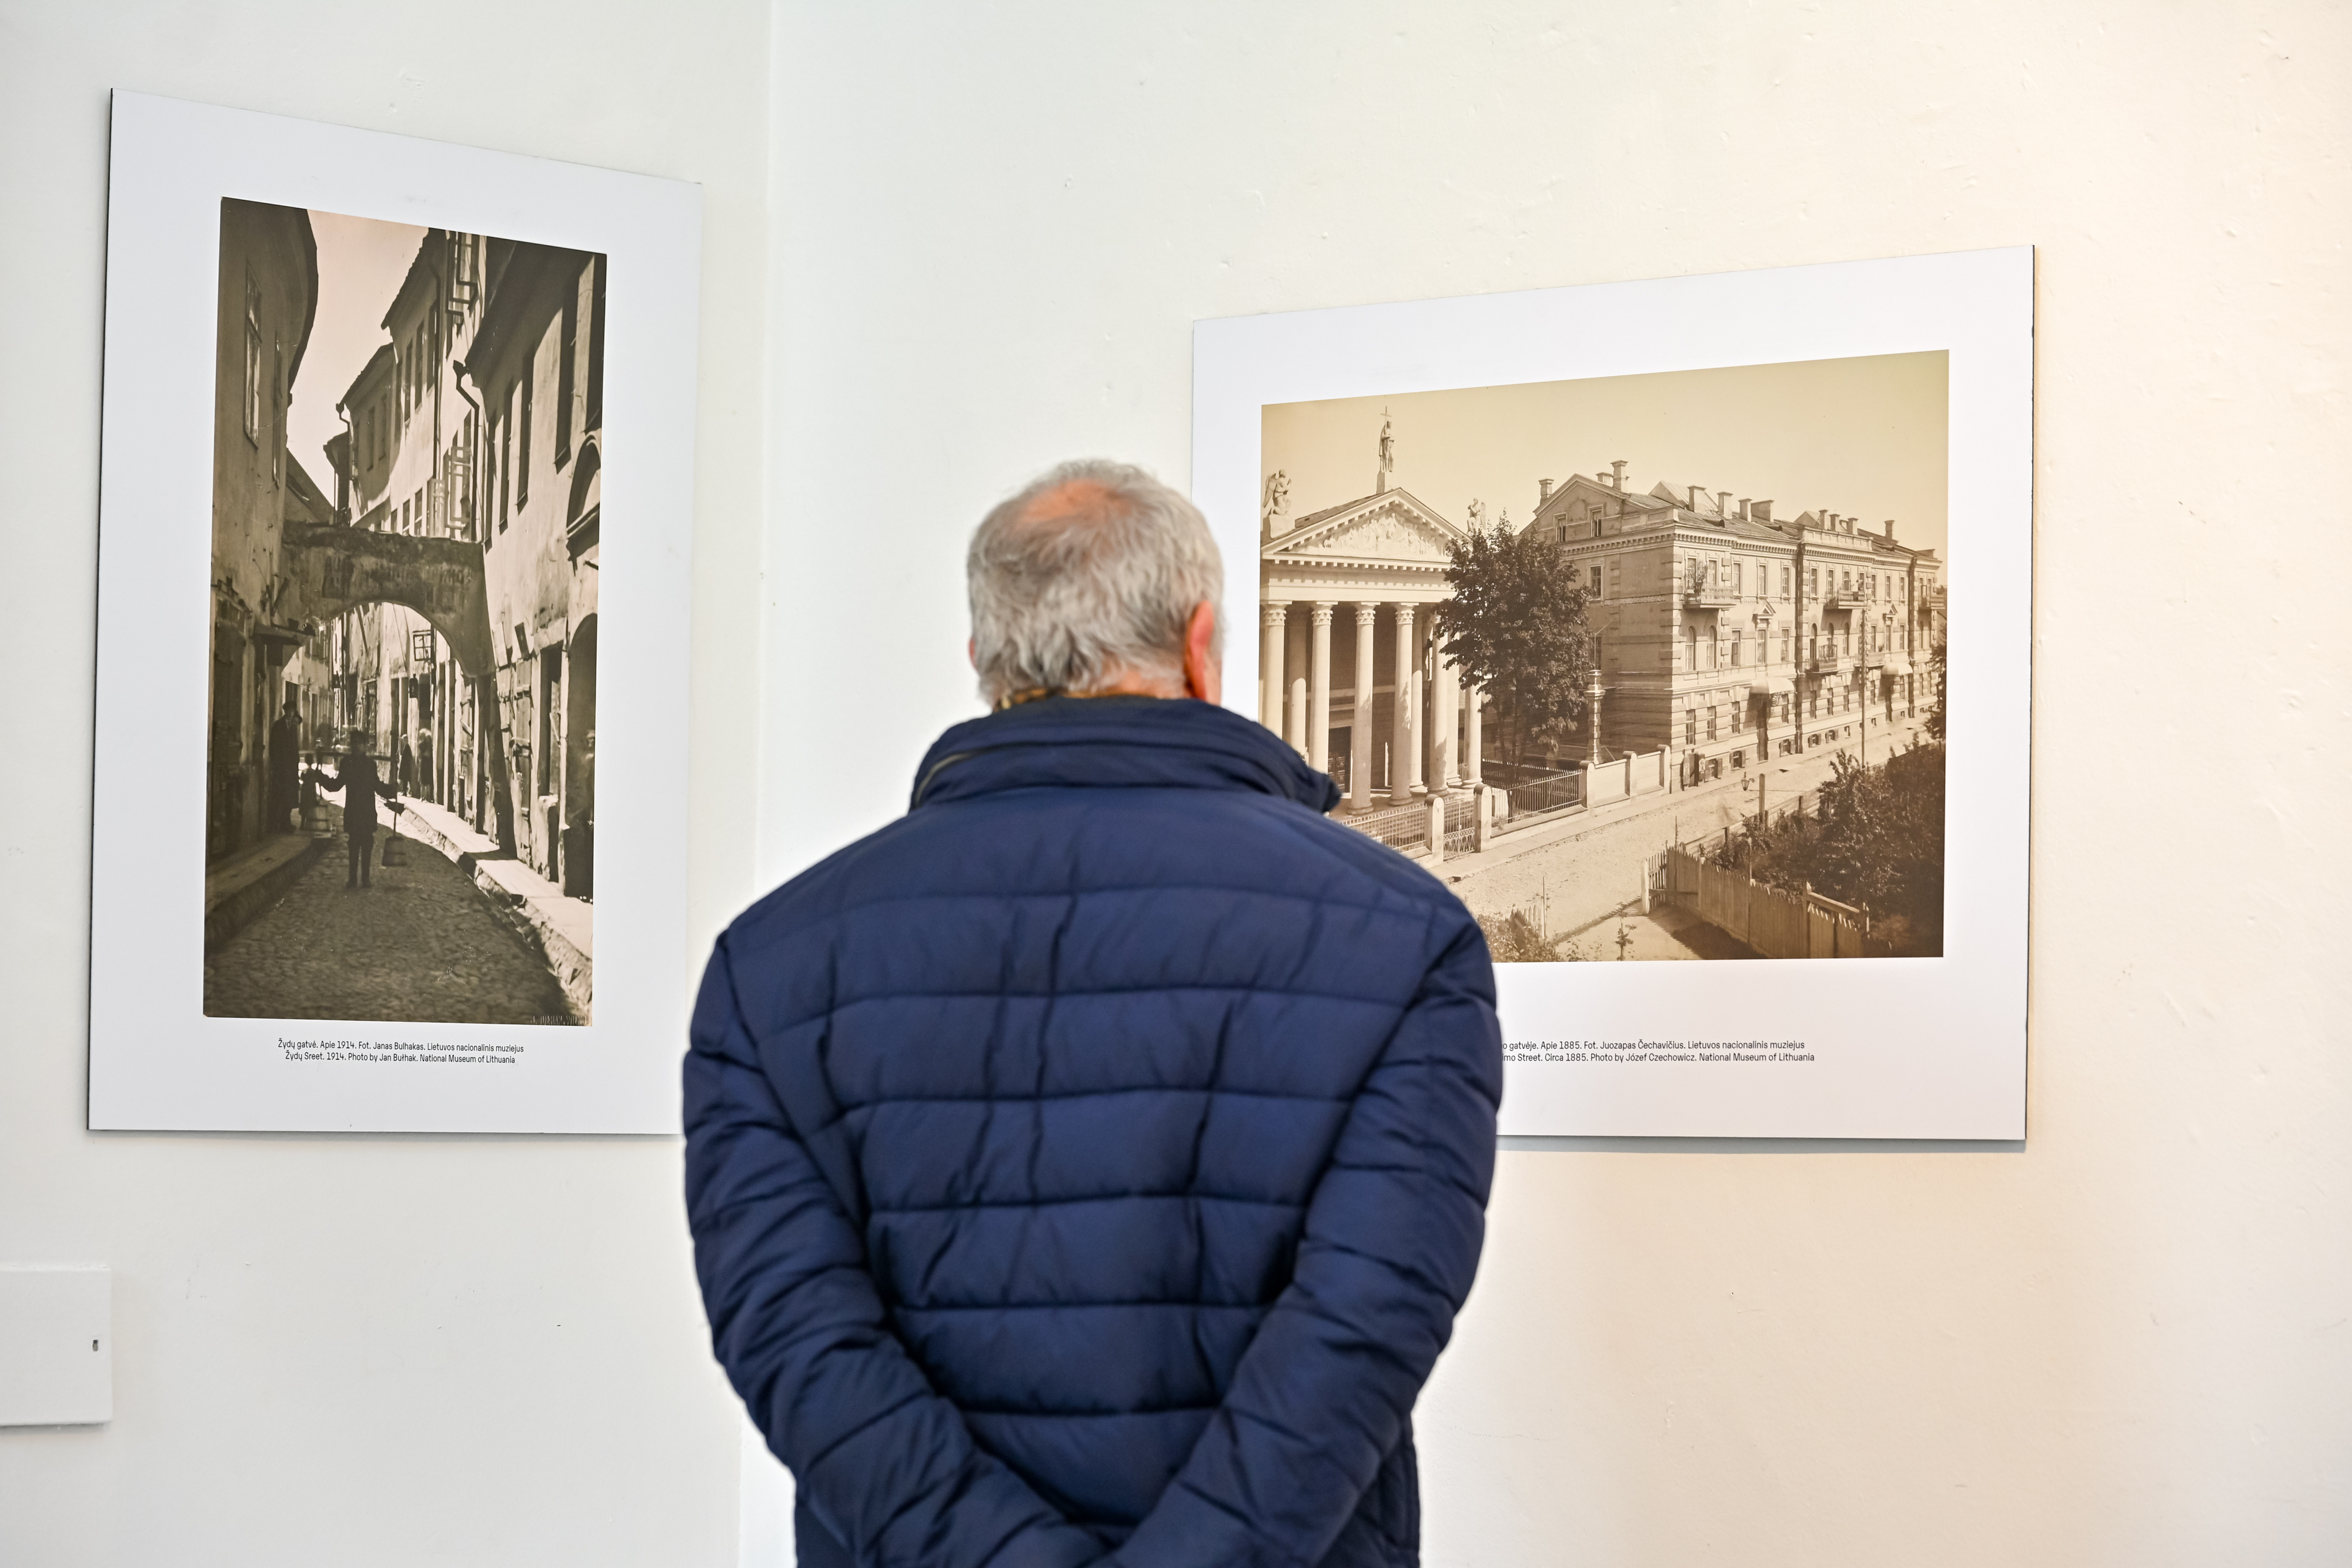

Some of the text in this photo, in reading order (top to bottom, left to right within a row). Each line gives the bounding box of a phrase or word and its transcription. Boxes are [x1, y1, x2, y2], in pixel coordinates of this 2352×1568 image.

[278, 1038, 295, 1049] Žydų
[297, 1041, 318, 1049] gatvė.
[320, 1041, 335, 1050] Apie
[338, 1041, 356, 1049] 1914.
[395, 1042, 425, 1050] Bulhakas.
[427, 1042, 455, 1051] Lietuvos
[496, 1044, 524, 1054] muziejus
[1509, 1041, 1539, 1051] gatvėje.
[1541, 1041, 1557, 1051] Apie
[1600, 1041, 1636, 1051] Juozapas
[1638, 1039, 1686, 1049] Čechavičius.
[1688, 1041, 1720, 1049] Lietuvos
[1770, 1041, 1805, 1051] muziejus
[285, 1049, 302, 1061] Žydų
[305, 1052, 324, 1060] Sreet.
[370, 1054, 377, 1062] by
[393, 1054, 417, 1062] Bułhak.
[486, 1055, 515, 1064] Lithuania
[1502, 1053, 1515, 1061] imo
[1518, 1053, 1542, 1061] Street.
[1545, 1053, 1563, 1061] Circa
[1566, 1053, 1588, 1061] 1885.
[1591, 1053, 1612, 1061] Photo
[1615, 1053, 1623, 1063] by
[1626, 1052, 1647, 1061] Józef
[1649, 1053, 1696, 1061] Czechowicz.
[1769, 1052, 1776, 1061] of
[1779, 1052, 1815, 1061] Lithuania
